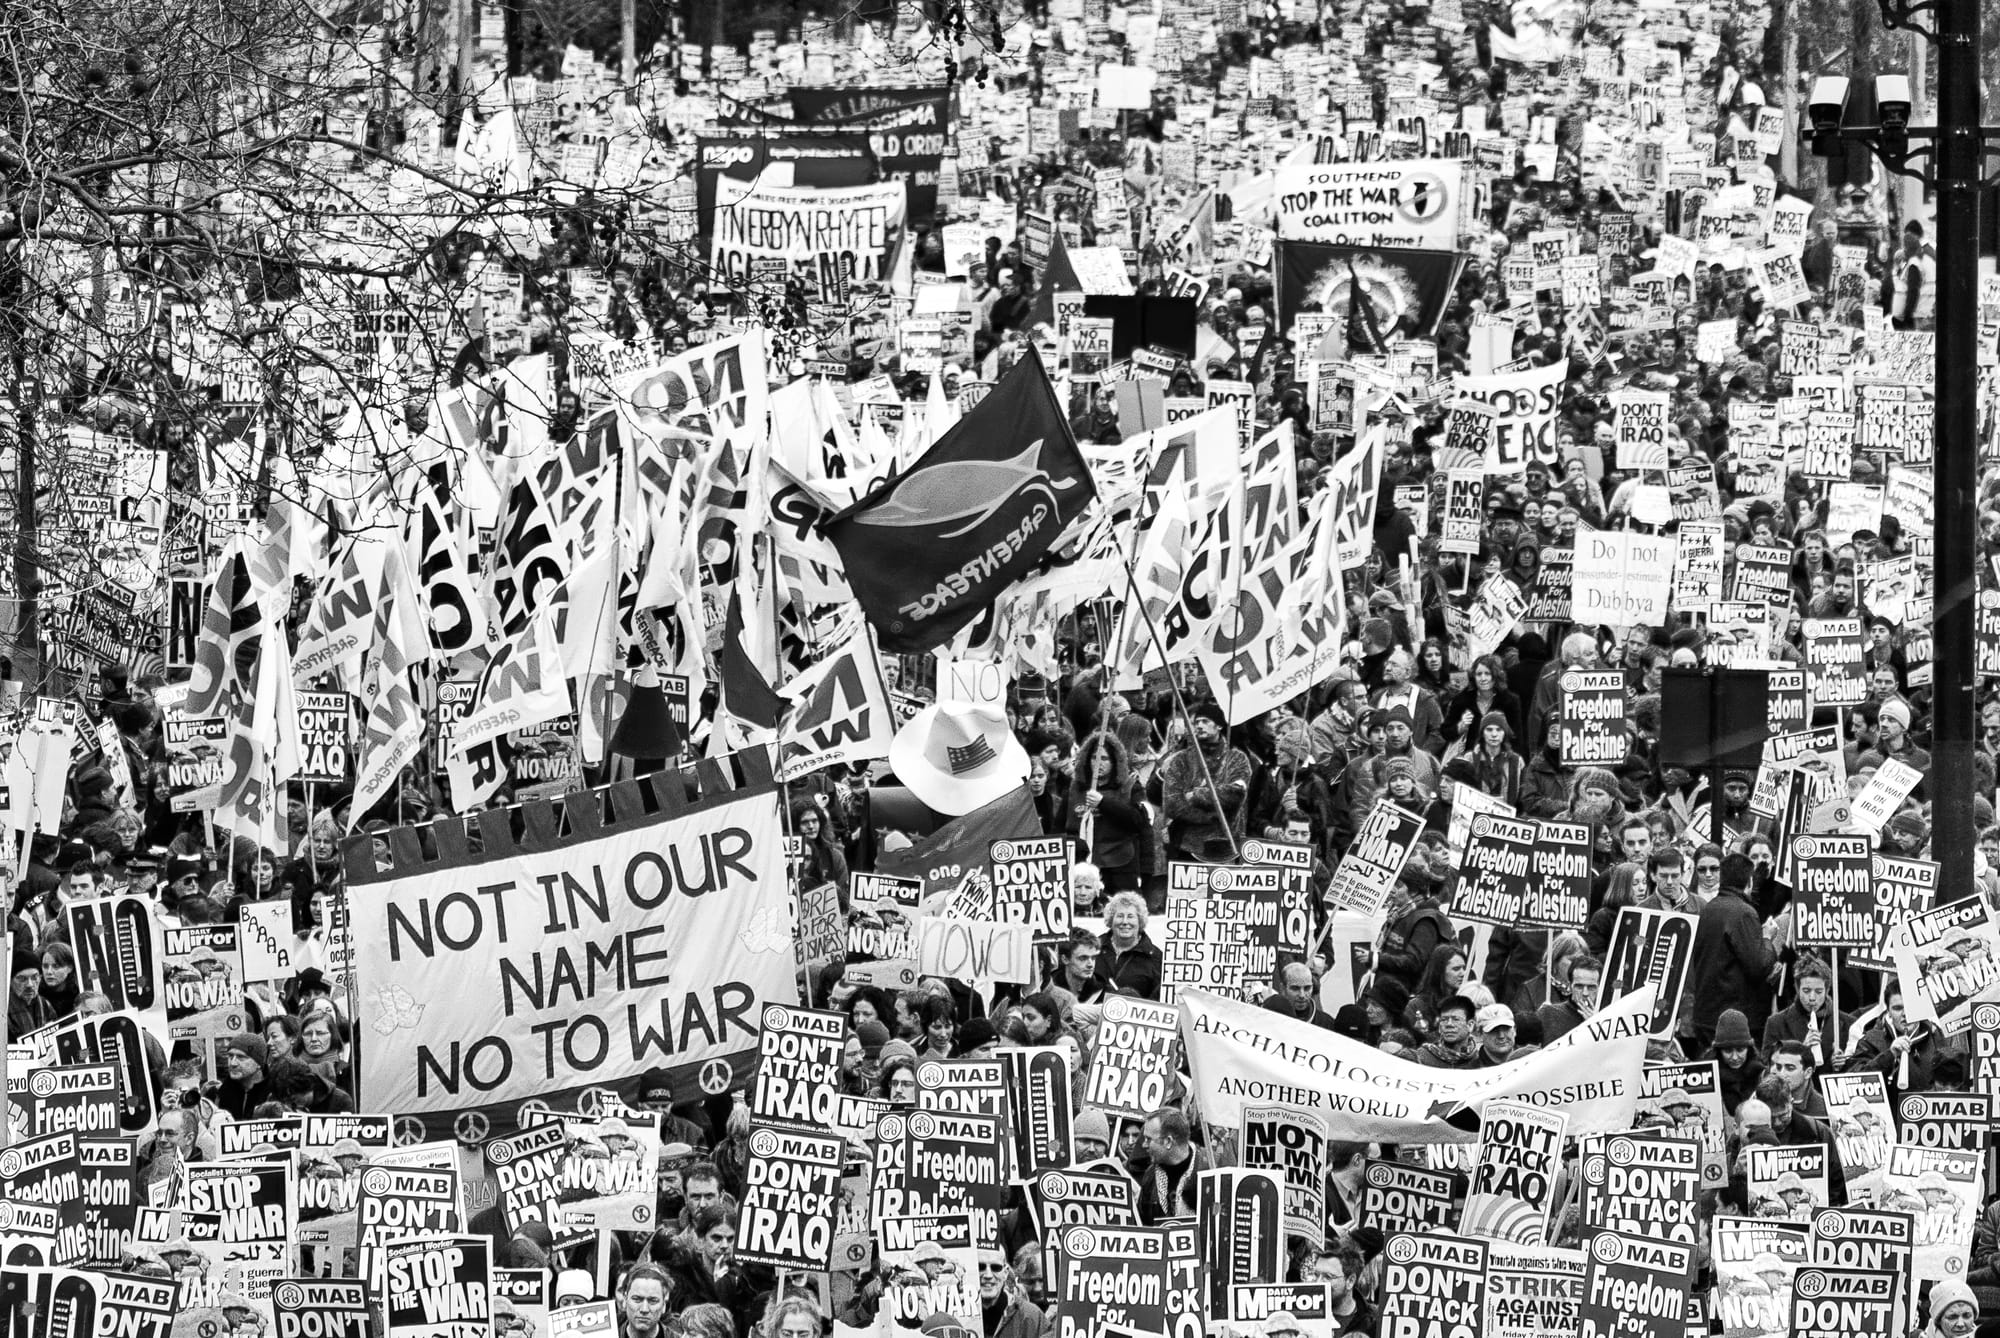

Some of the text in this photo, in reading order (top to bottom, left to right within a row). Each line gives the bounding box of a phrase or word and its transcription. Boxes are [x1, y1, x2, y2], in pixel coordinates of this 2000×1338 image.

[1308, 171, 1401, 184] SOUTHEND
[1281, 187, 1401, 214] STOP THE WAR
[1303, 212, 1393, 227] COALITION
[354, 315, 410, 333] BUSH
[1080, 330, 1097, 339] NO
[1073, 340, 1108, 351] WAR
[1621, 403, 1663, 416] DON'T
[1863, 400, 1905, 414] DON'T
[1451, 423, 1489, 438] ATTACK
[1453, 410, 1493, 429] DON'T
[1622, 416, 1663, 427] ATTACK
[1446, 433, 1487, 456] IRAQ
[1621, 428, 1663, 444] IRAQ
[1808, 427, 1855, 442] DON'T
[1863, 424, 1904, 448] IRAQ
[1804, 452, 1851, 476] IRAQ
[1592, 540, 1659, 562] Do not
[1756, 550, 1789, 562] MAB
[1824, 622, 1859, 633] MAB
[1806, 640, 1863, 664] Freedom
[1584, 676, 1621, 687] MAB
[1826, 664, 1844, 676] For
[952, 664, 1000, 702] NO
[1808, 672, 1867, 701] Palestine
[308, 698, 344, 708] MAB
[1564, 693, 1623, 720] Freedom
[168, 723, 225, 741] Mirror
[1584, 721, 1603, 732] For
[1562, 729, 1625, 761] Palestine
[169, 764, 192, 787] NO
[516, 756, 580, 780] NO WAR
[1884, 785, 1904, 799] WAR
[1017, 842, 1062, 856] MAB
[1464, 838, 1528, 877] Freedom
[1820, 842, 1865, 855] MAB
[993, 859, 1066, 886] DON'T
[1236, 874, 1276, 887] MAB
[1480, 873, 1500, 887] For
[1544, 875, 1563, 890] For
[1798, 861, 1869, 893] Freedom
[386, 881, 517, 962] NOT
[537, 865, 610, 934] IN
[624, 827, 758, 911] OUR
[996, 882, 1067, 903] ATTACK
[1452, 876, 1520, 921] Palestine
[1822, 893, 1845, 906] For
[1167, 899, 1197, 919] HAS
[1166, 920, 1206, 940] SEEN
[1796, 903, 1873, 942] Palestine
[848, 927, 875, 954] NO
[1165, 942, 1204, 961] FLIES
[500, 925, 670, 1016] NAME
[1163, 963, 1242, 984] FEED OFF
[416, 981, 759, 1098] NO TO WAR
[1098, 1021, 1177, 1054] DON'T
[1588, 1013, 1650, 1043] WAR
[760, 1031, 845, 1065] DON'T
[759, 1056, 839, 1085] ATTACK
[1096, 1045, 1169, 1076] ATTACK
[948, 1068, 999, 1082] MAB
[1086, 1063, 1165, 1112] IRAQ
[1218, 1076, 1409, 1120] ANOTHER WORLD
[754, 1075, 837, 1132] IRAQ
[1932, 1102, 1984, 1117] MAB
[309, 1117, 387, 1145] Mirror
[514, 1128, 562, 1154] MAB
[1247, 1121, 1323, 1158] NOT
[1483, 1119, 1558, 1154] DON'T
[1902, 1123, 1990, 1149] DON'T
[24, 1139, 72, 1166] MAB
[415, 1151, 450, 1162] Coalition
[912, 1141, 995, 1185] Freedom
[1246, 1147, 1322, 1176] IN MY
[1479, 1143, 1552, 1175] ATTACK
[190, 1168, 253, 1179] Socialist Worker
[395, 1177, 448, 1193] MAB
[564, 1156, 657, 1193] NO WAR
[746, 1158, 841, 1196] DON'T
[1608, 1167, 1700, 1199] DON'T
[190, 1176, 261, 1212] STOP
[939, 1182, 966, 1199] For
[1472, 1164, 1547, 1212] IRAQ
[743, 1186, 835, 1217] ATTACK
[1365, 1188, 1453, 1225] DON'T
[1606, 1197, 1697, 1225] ATTACK
[16, 1209, 54, 1229] MAB
[363, 1198, 454, 1230] DON'T
[737, 1206, 831, 1263] IRAQ
[885, 1219, 969, 1250] Mirror
[387, 1239, 454, 1258] Socialist Worker
[247, 1269, 283, 1278] guerra
[388, 1247, 464, 1293] STOP
[1490, 1254, 1586, 1273] Youth against the war
[112, 1283, 170, 1306] MAB
[1066, 1260, 1160, 1306] Freedom
[1385, 1265, 1485, 1301] DON'T
[1488, 1276, 1585, 1298] STRIKE
[1590, 1264, 1684, 1320] Freedom
[1830, 1279, 1888, 1294] MAB
[308, 1288, 361, 1304] MAB
[391, 1282, 488, 1324] THE WAR
[1238, 1288, 1323, 1319] Mirror
[1382, 1293, 1480, 1327] ATTACK
[1496, 1313, 1534, 1328] THE
[1795, 1301, 1892, 1332] DON'T
[279, 1311, 370, 1338] DON'T
